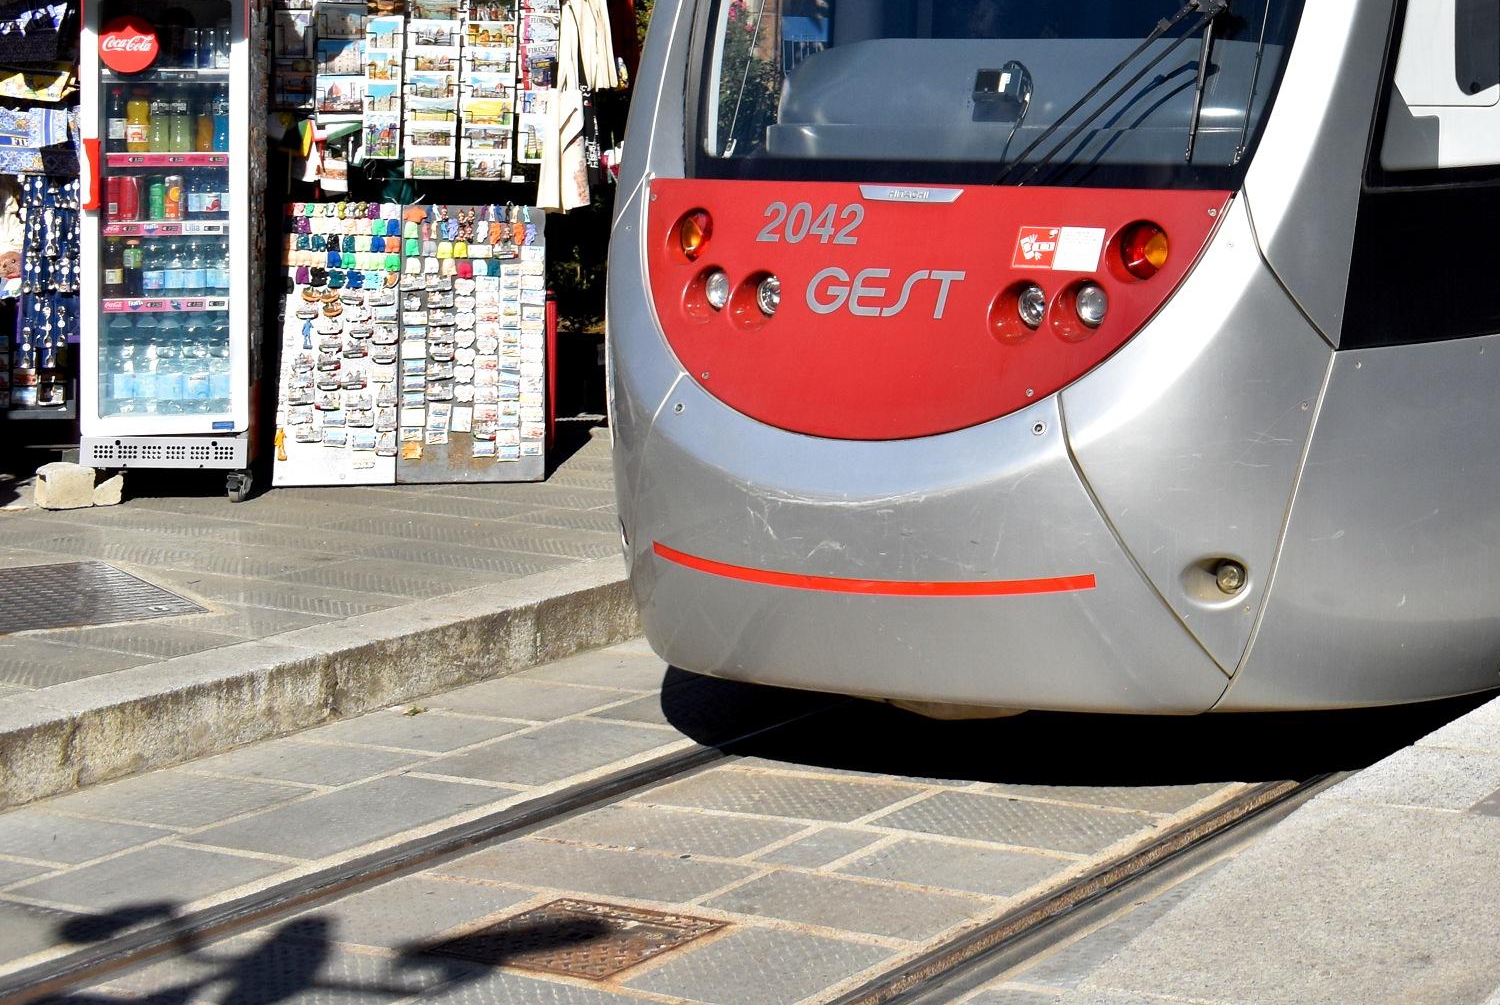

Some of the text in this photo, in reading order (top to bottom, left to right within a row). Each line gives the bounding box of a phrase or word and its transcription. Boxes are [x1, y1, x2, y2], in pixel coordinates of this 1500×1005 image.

[102, 35, 155, 52] Coca-Cola
[756, 202, 865, 245] 2042
[804, 267, 967, 320] GEST
